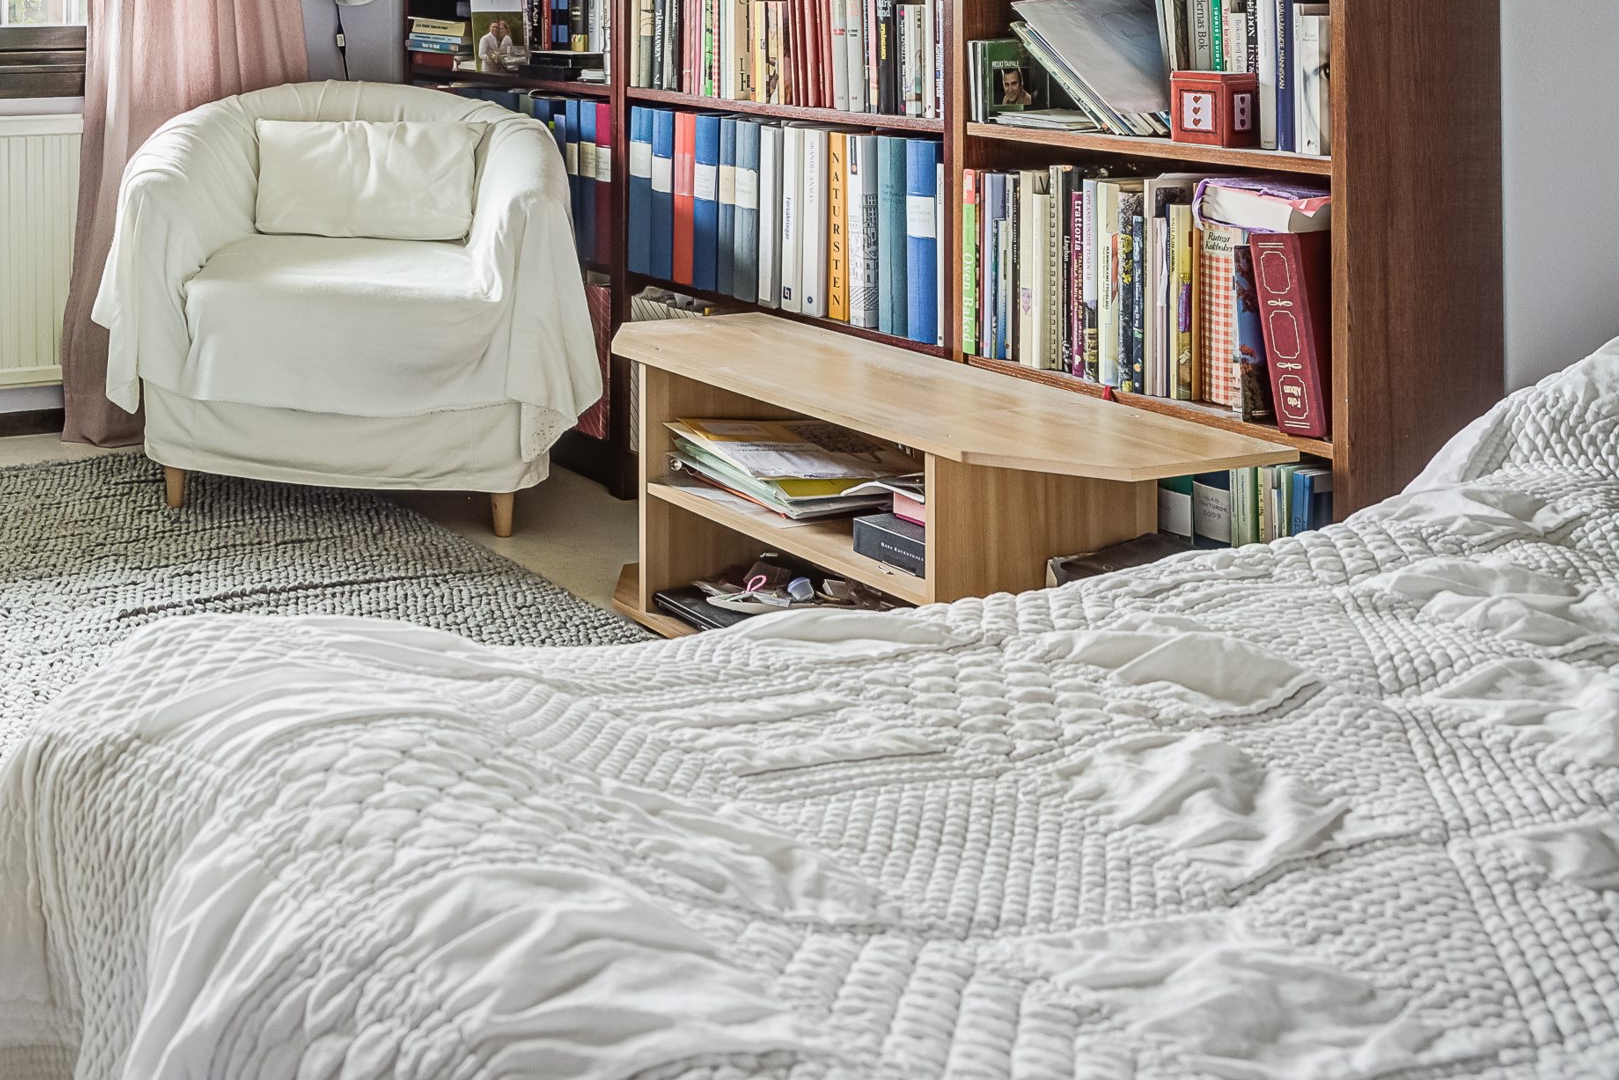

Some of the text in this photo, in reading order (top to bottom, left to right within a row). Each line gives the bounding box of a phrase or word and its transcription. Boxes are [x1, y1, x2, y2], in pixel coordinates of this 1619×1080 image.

[1198, 32, 1208, 50] Bok
[784, 196, 792, 240] Försäkringar
[832, 152, 840, 306] NATURSTEN
[1073, 200, 1083, 251] trattoria
[963, 252, 974, 294] Oven
[963, 297, 976, 342] Baked
[1284, 384, 1302, 395] Album
[1288, 397, 1301, 408] Foto
[1203, 510, 1221, 520] 2009
